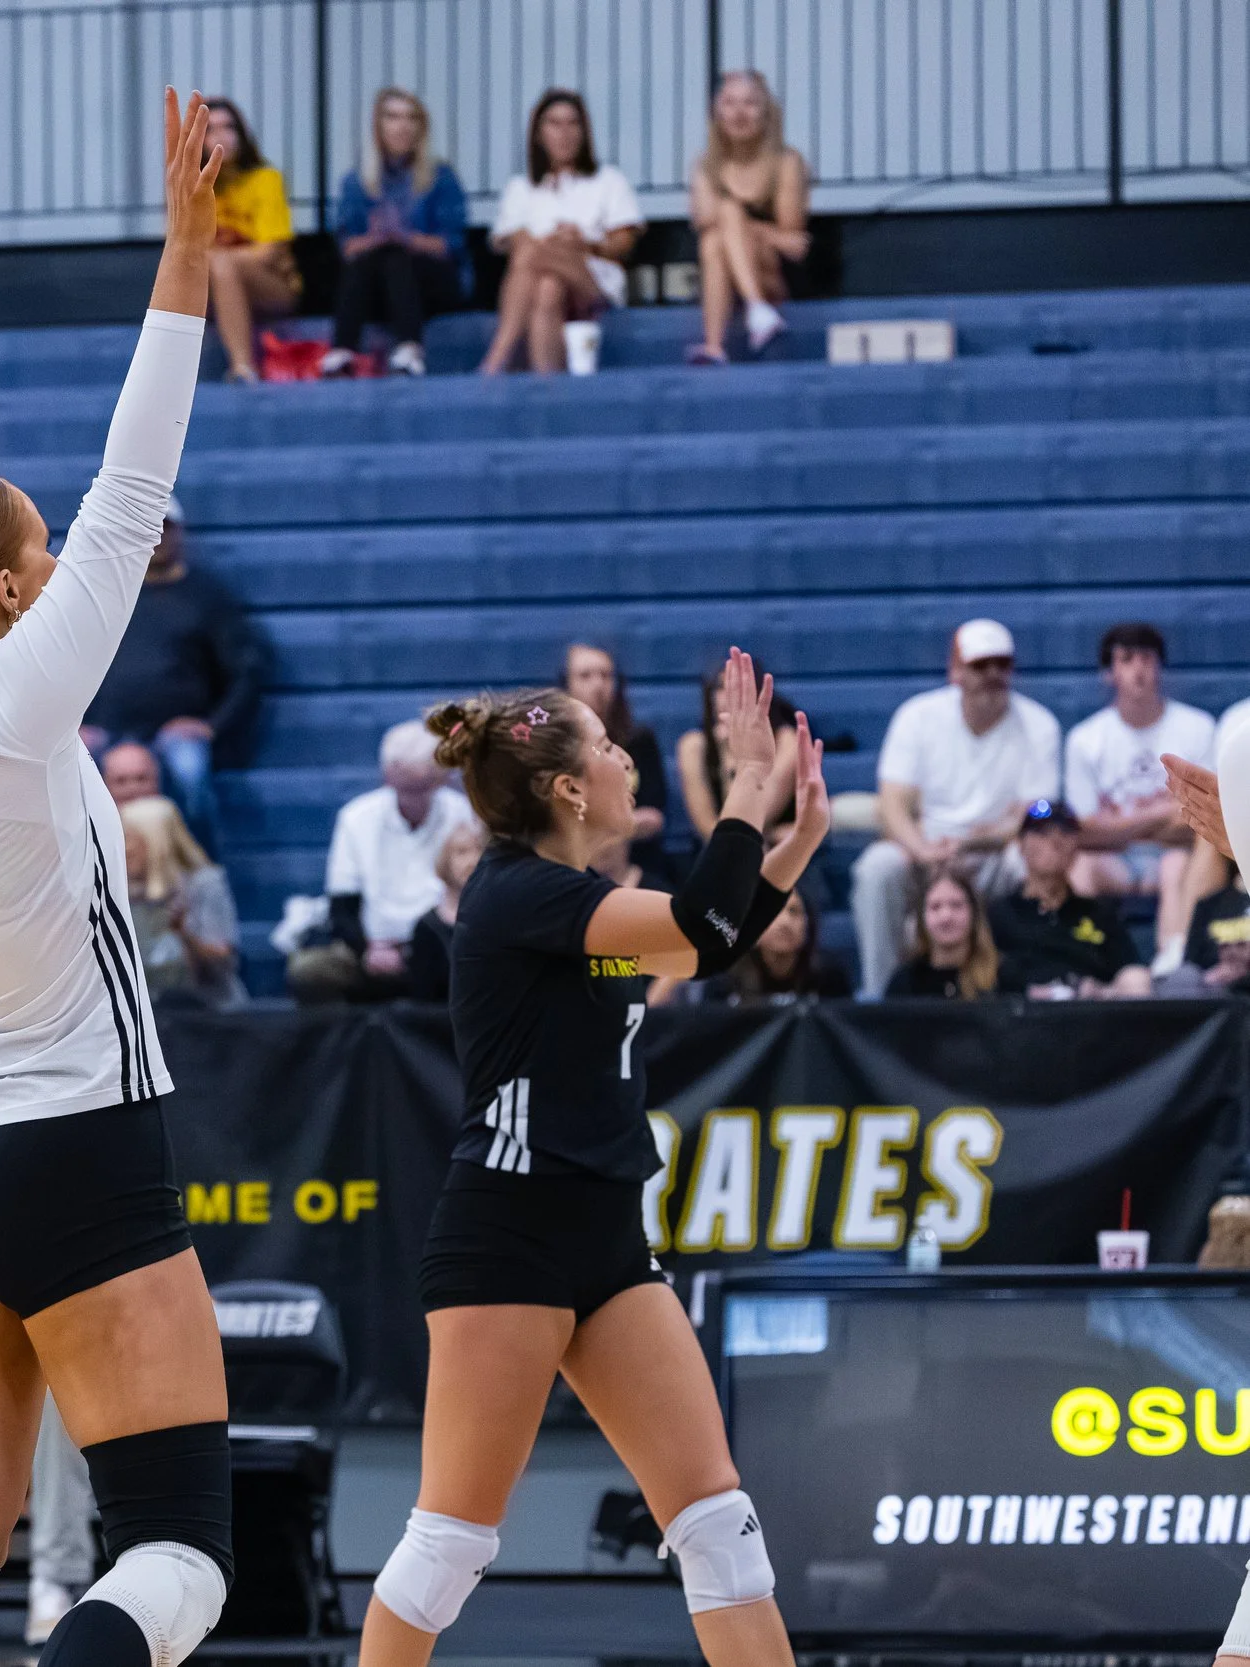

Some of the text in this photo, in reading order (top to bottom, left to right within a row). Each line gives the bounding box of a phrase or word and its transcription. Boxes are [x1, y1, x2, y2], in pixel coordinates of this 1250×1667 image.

[620, 1003, 646, 1080] 7
[293, 1178, 380, 1224] OF
[1050, 1386, 1250, 1456] @SU
